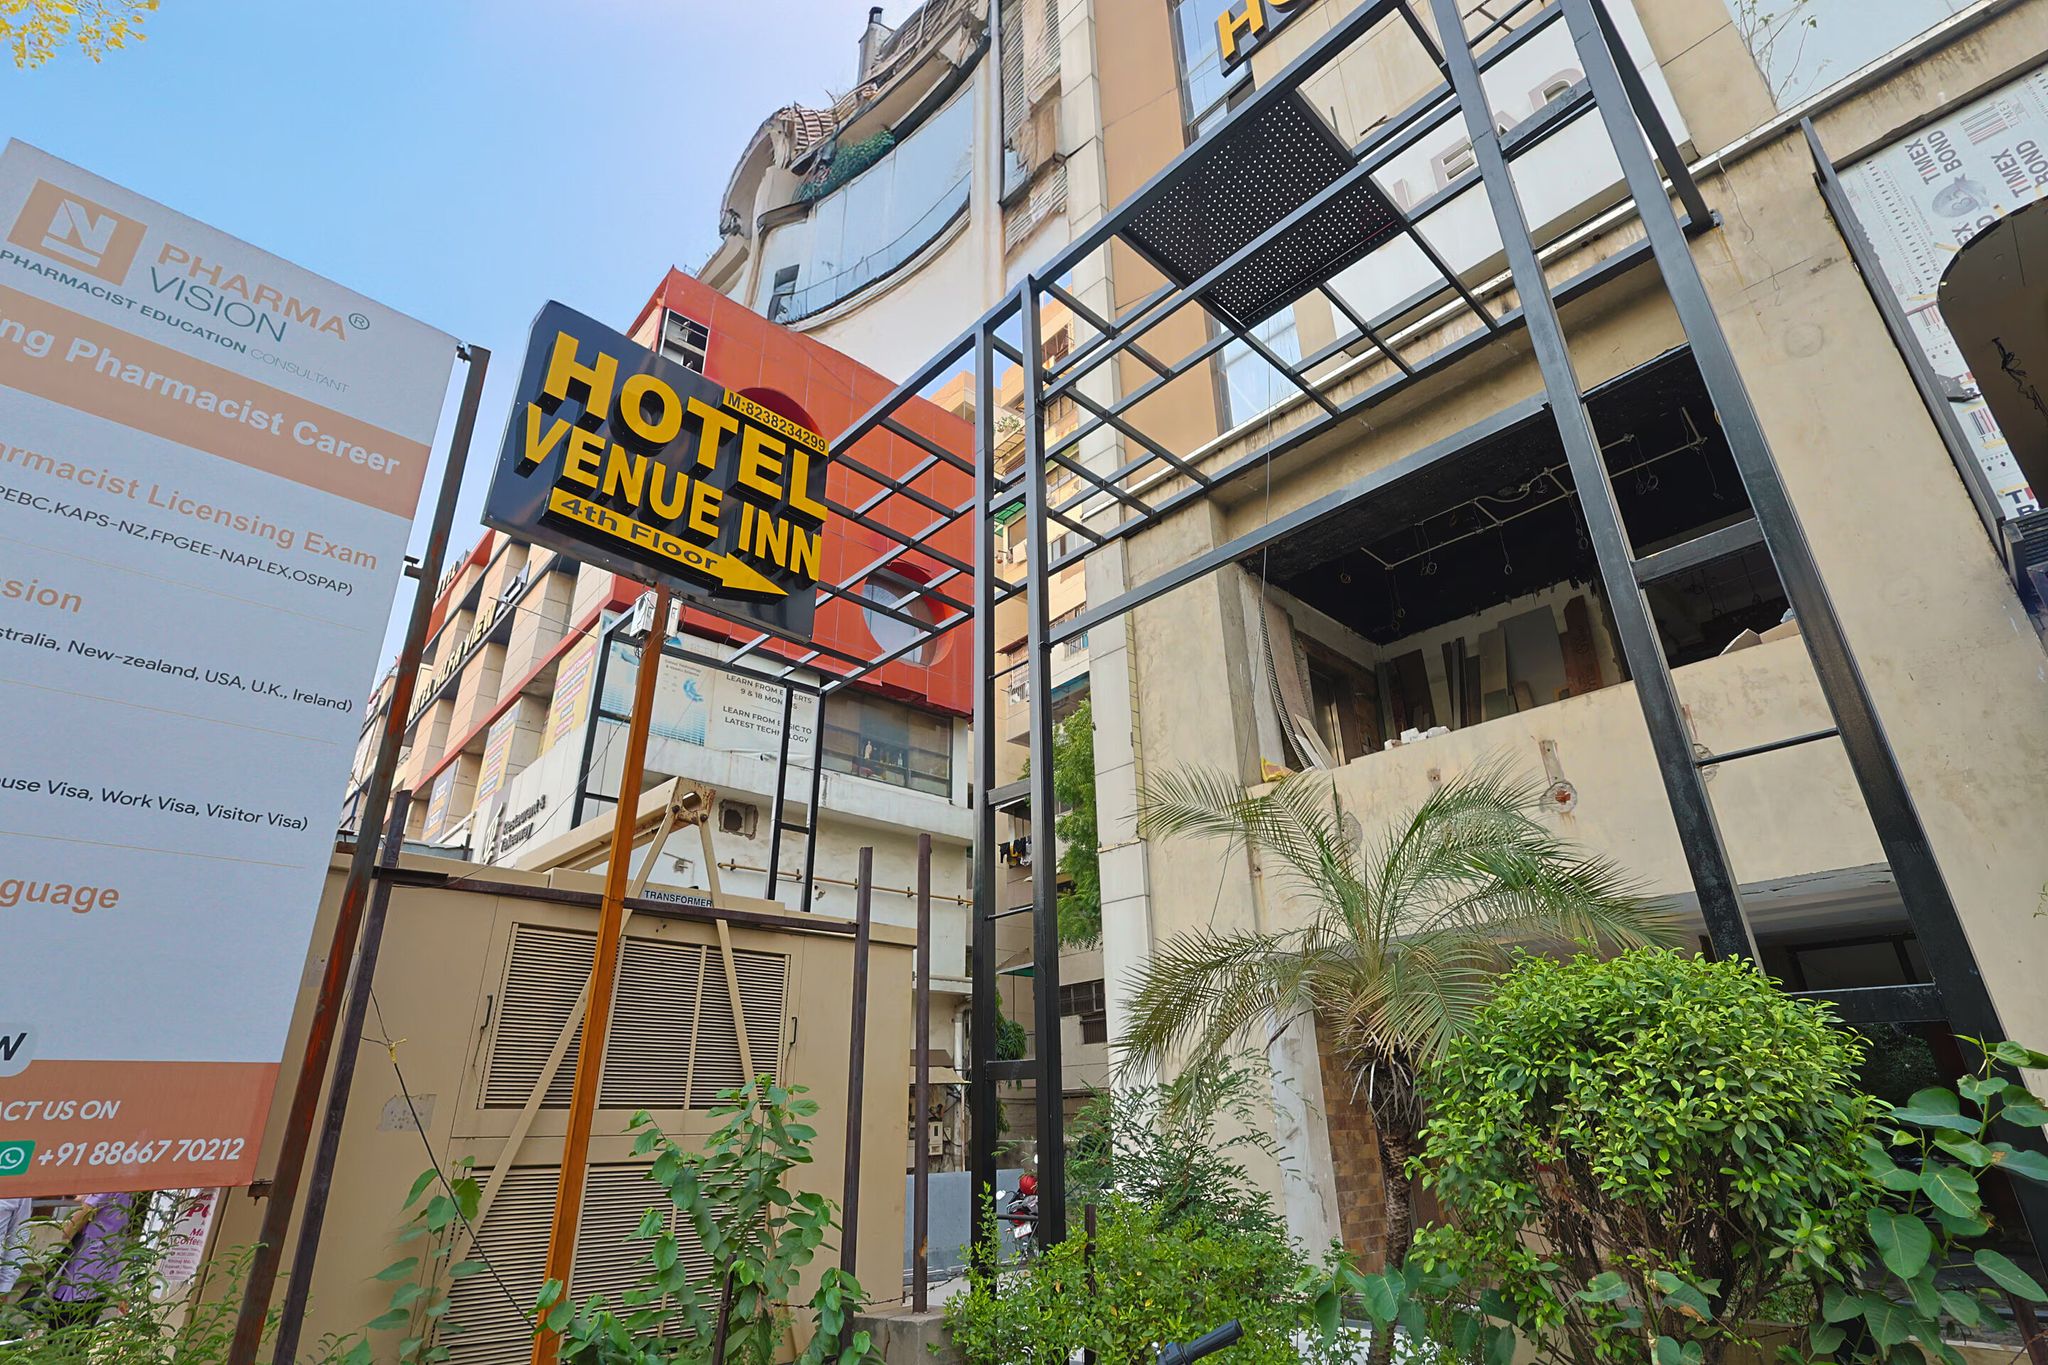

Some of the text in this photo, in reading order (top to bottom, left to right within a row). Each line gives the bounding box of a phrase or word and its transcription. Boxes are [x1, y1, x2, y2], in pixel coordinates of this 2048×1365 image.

[1905, 138, 1941, 185] TIMEX
[1927, 130, 1963, 173] BOND
[1991, 148, 2032, 198] TIMEX
[0, 250, 351, 393] PHARMACIST EDUCATION CONSULTANT
[151, 266, 287, 343] VISION
[64, 335, 284, 437] Pharmacist
[292, 419, 401, 476] Career
[543, 330, 828, 522] HOTEL
[727, 391, 827, 453] M:8238234299
[523, 401, 822, 582] VENUE INN
[147, 483, 296, 551] Licensing
[304, 530, 378, 570] Exam
[560, 498, 718, 571] 4th Floor
[68, 640, 200, 681] New-zealand,
[205, 670, 246, 690] USA,
[293, 688, 353, 713] Ireland)
[726, 673, 813, 704] LEARN FROM EERTS
[722, 705, 751, 718] LEARN
[752, 713, 776, 725] FROM
[801, 726, 812, 735] TO
[724, 716, 755, 729] LATEST
[764, 695, 798, 709] MONS
[47, 780, 94, 802] Visa,
[101, 787, 153, 808] Work
[158, 796, 200, 816] Visa,
[206, 803, 263, 824] Visitor
[267, 813, 309, 831] Visa)
[644, 889, 713, 908] TRANSFORMER
[0, 1100, 121, 1121] CT US ON
[38, 1138, 245, 1167] +91 88667 70212
